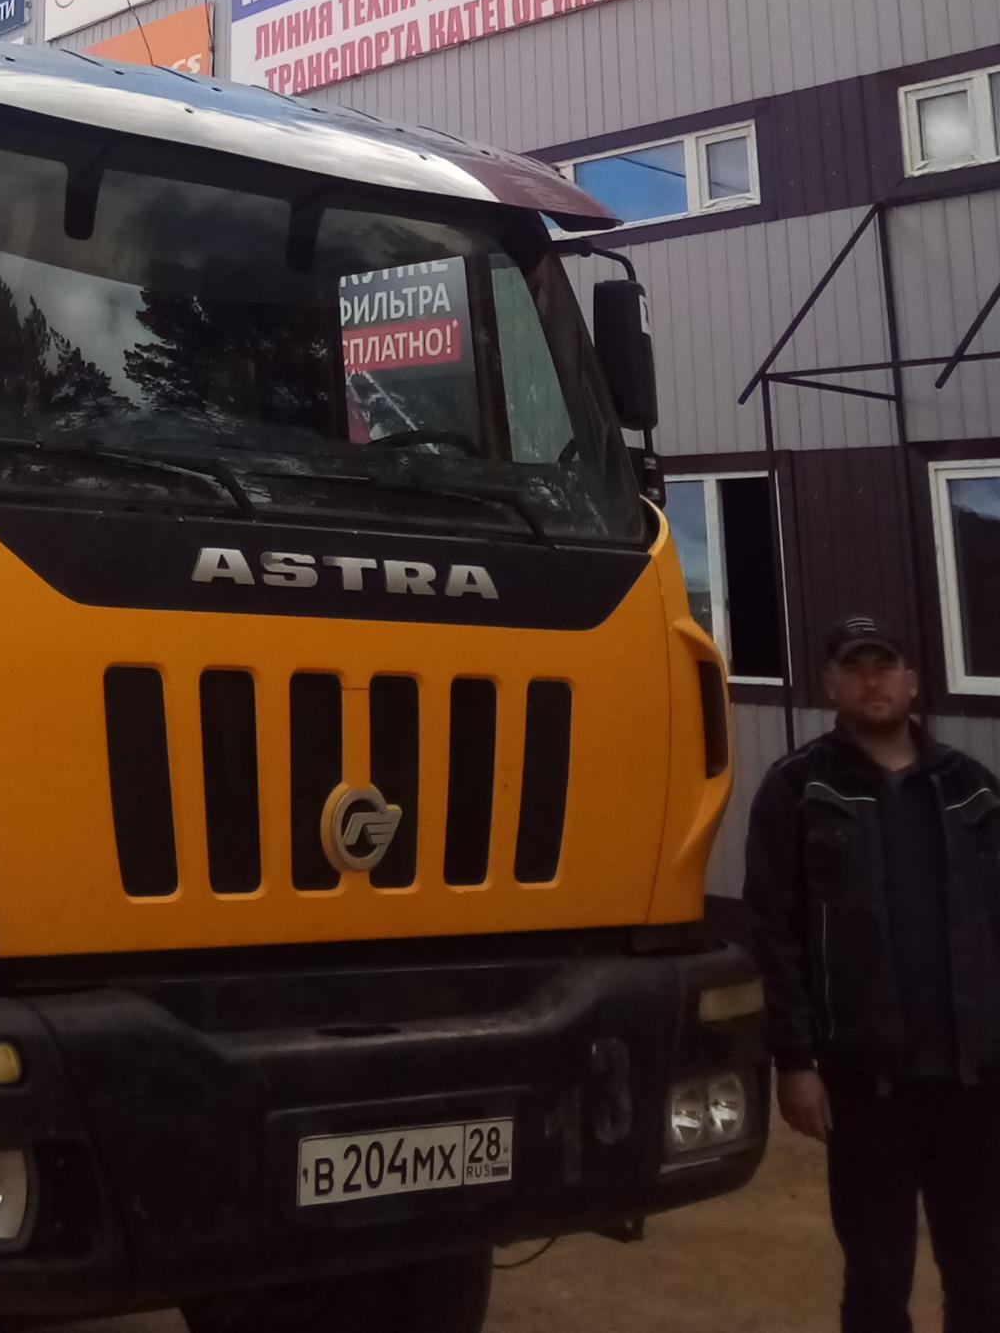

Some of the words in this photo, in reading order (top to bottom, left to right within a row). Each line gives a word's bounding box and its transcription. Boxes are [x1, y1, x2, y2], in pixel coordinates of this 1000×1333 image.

[254, 0, 333, 61] ЛИНИЯ
[264, 19, 423, 95] ТРАНСПОРТА
[191, 546, 500, 600] ASTRA
[465, 1165, 491, 1179] RUS
[468, 1126, 501, 1164] 28
